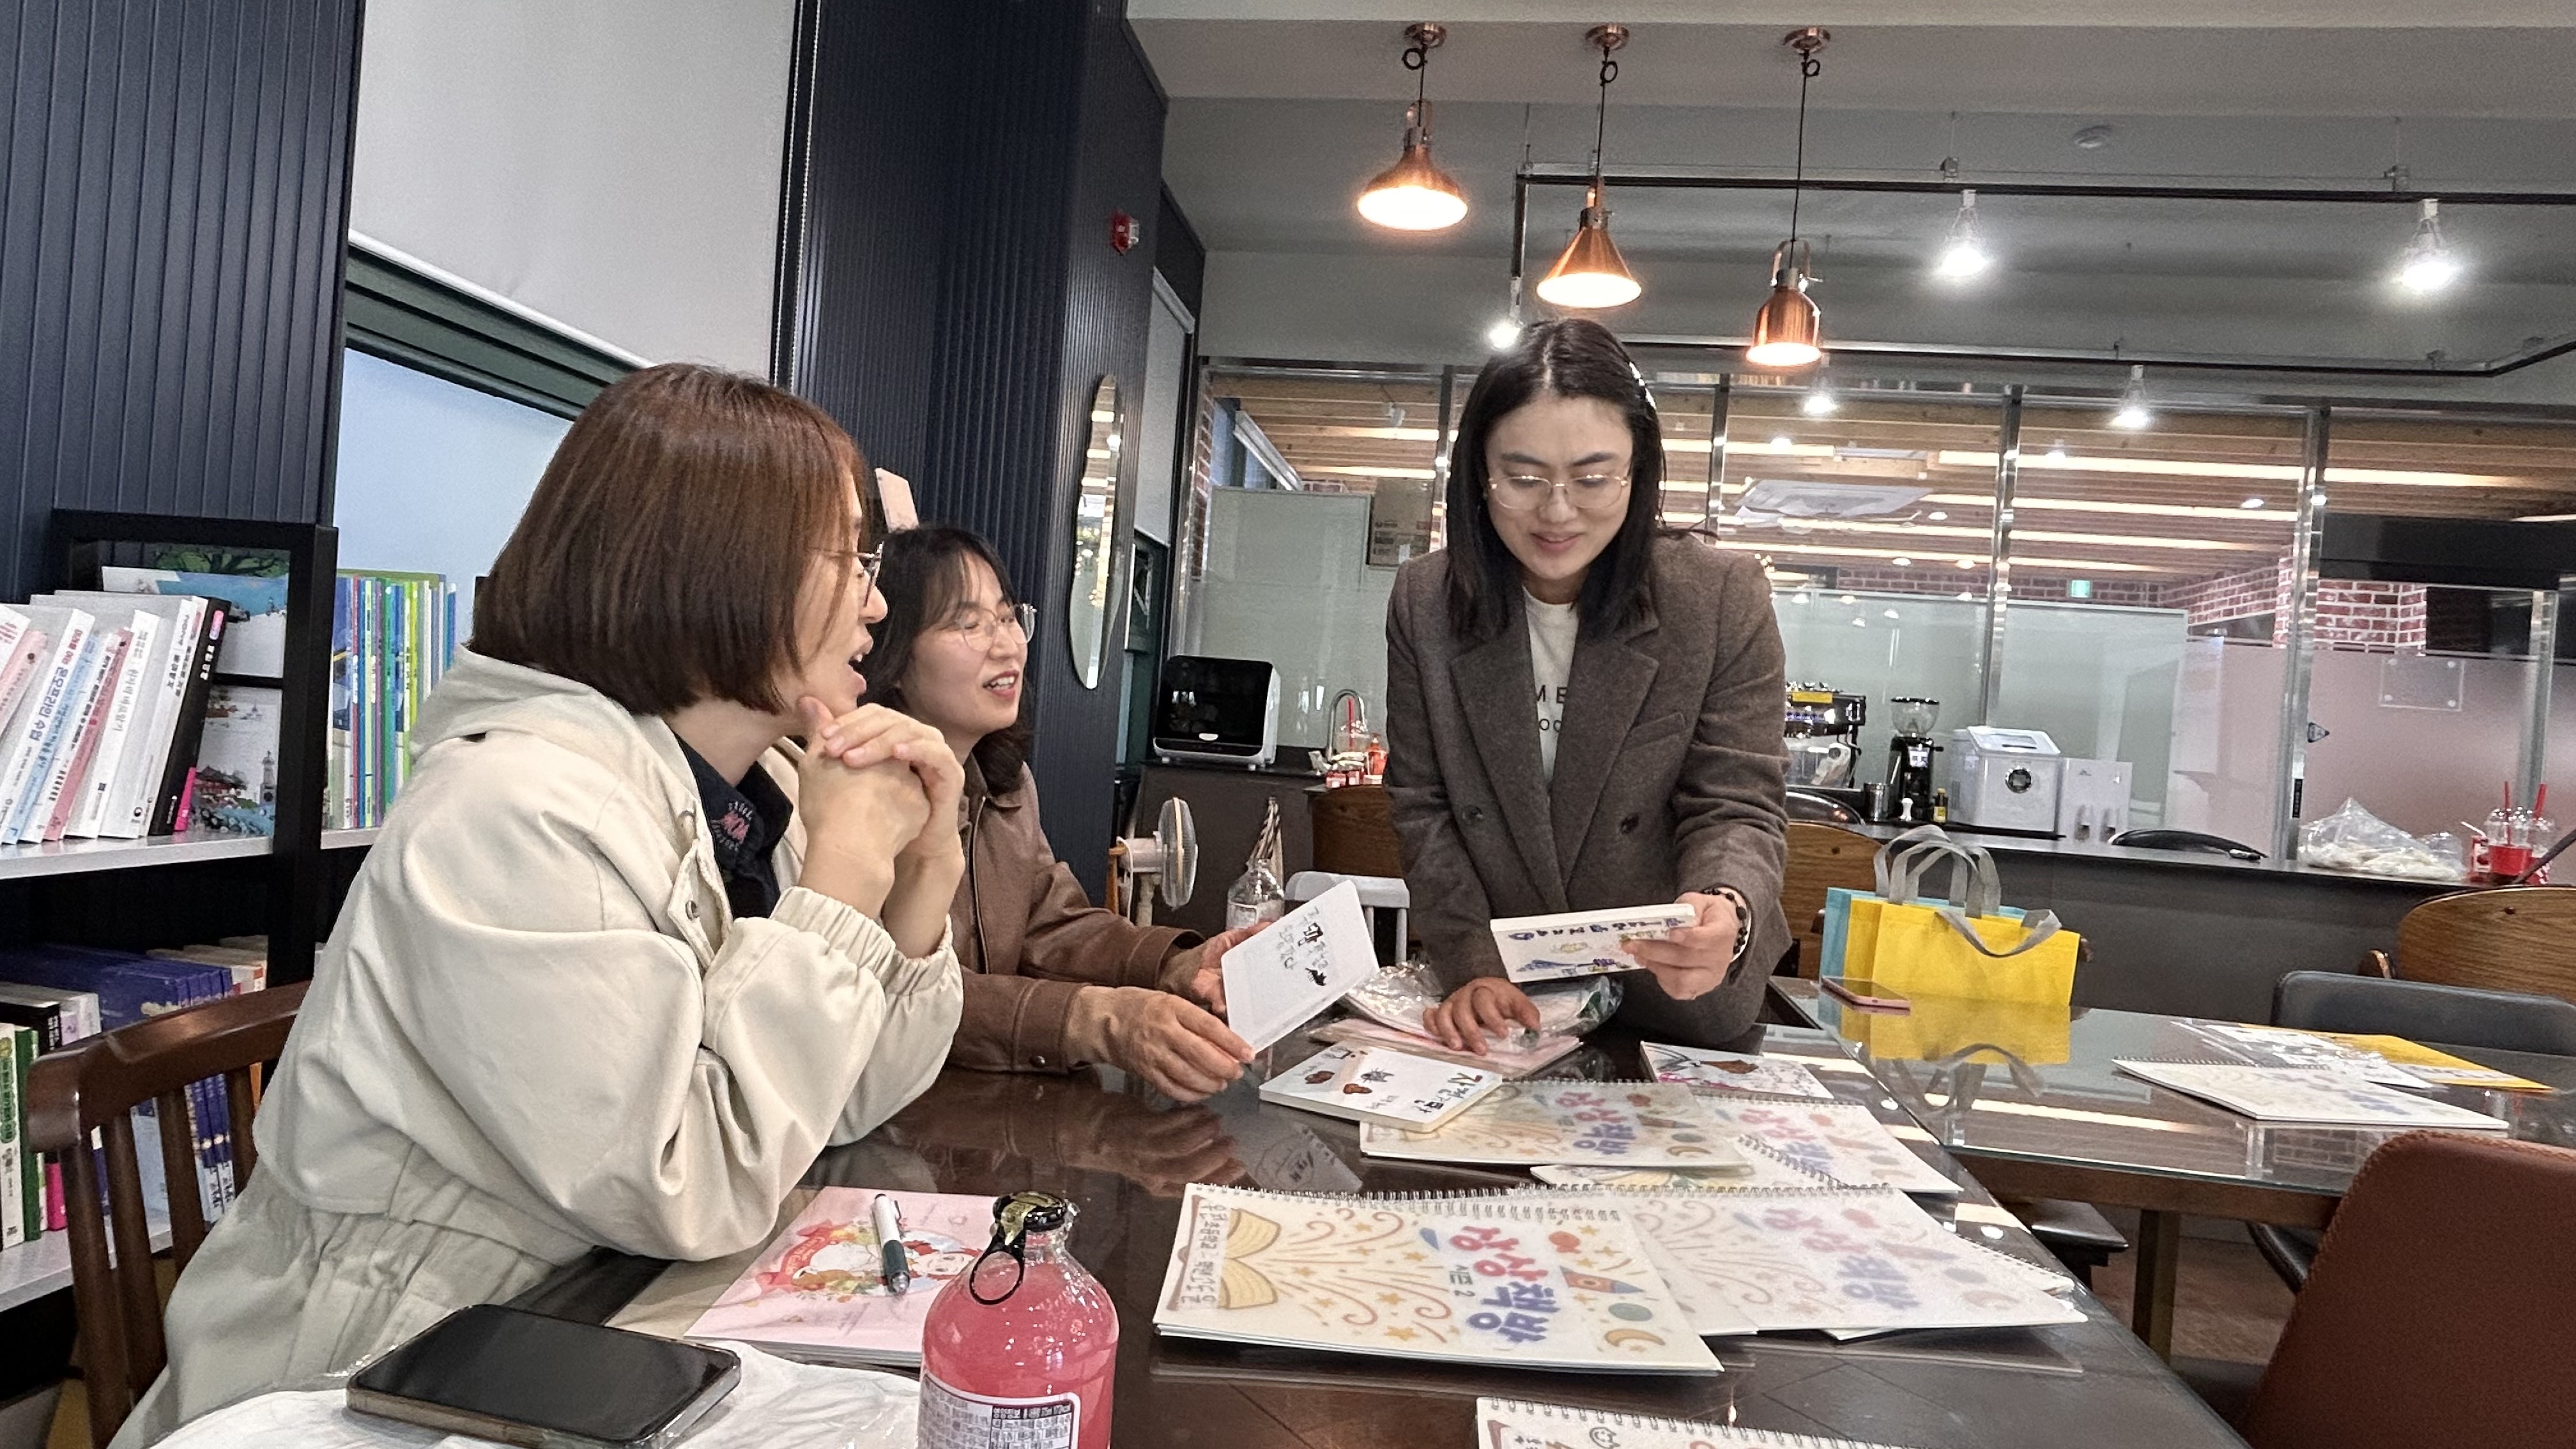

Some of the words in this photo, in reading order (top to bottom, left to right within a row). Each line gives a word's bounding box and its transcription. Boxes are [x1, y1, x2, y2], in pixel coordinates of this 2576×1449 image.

[29, 721, 46, 742] 수업
[1448, 1264, 1473, 1285] 시즌
[1450, 1225, 1561, 1343] 상상책방
[1453, 1289, 1476, 1298] 2
